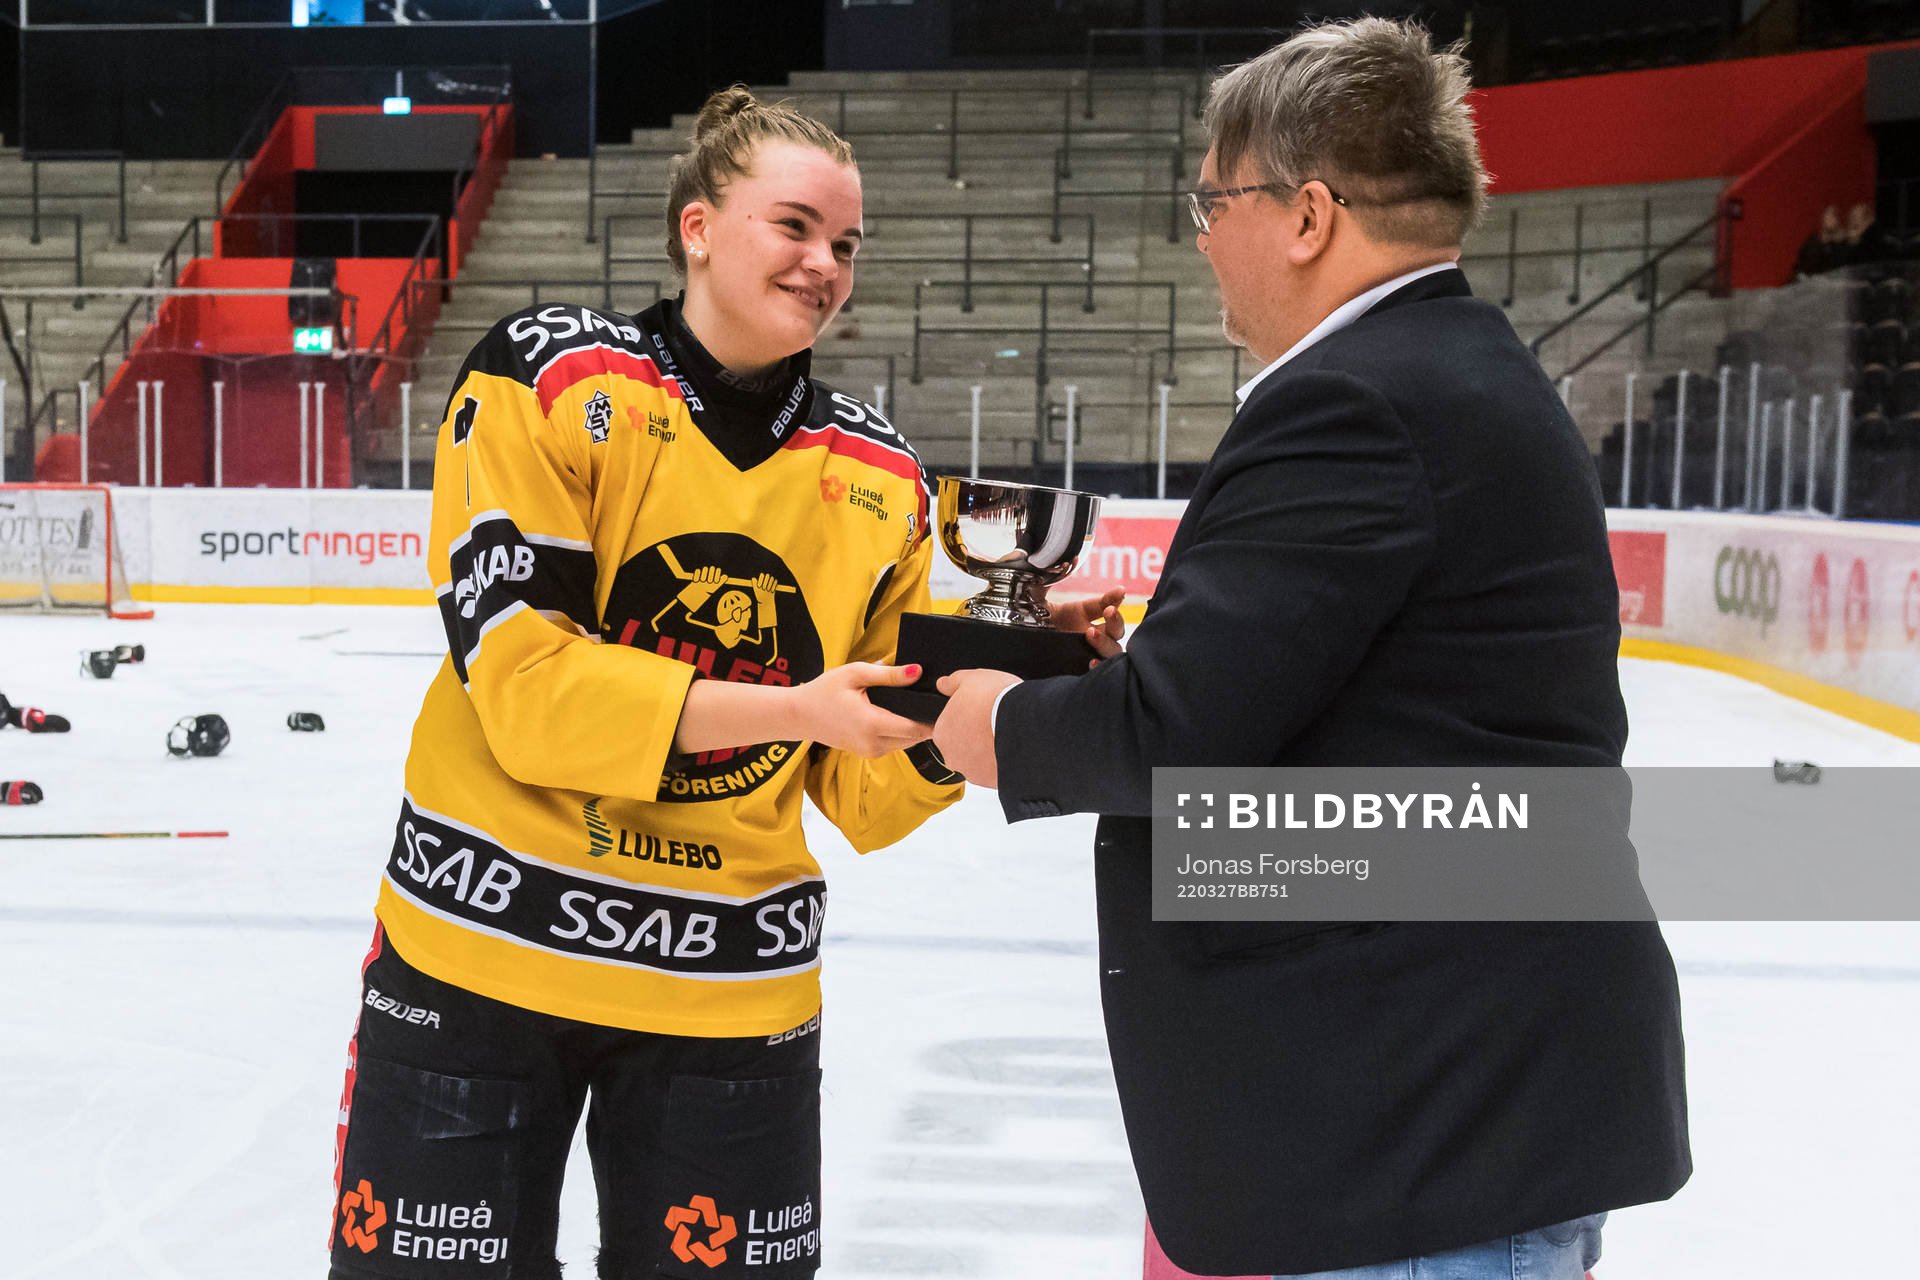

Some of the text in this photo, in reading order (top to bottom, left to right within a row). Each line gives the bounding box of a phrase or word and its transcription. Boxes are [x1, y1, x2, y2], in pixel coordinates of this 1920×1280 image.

[849, 495, 889, 522] Energi
[200, 527, 421, 565] sportringen
[473, 545, 535, 605] KAB
[659, 743, 788, 795] FÖRENING
[397, 820, 521, 914] SSAB
[617, 828, 723, 871] LULEBO
[550, 889, 718, 959] SSAB
[396, 1198, 492, 1229] Luleå
[748, 1193, 812, 1234] Luleå
[392, 1229, 508, 1264] Energi
[745, 1227, 819, 1266] Energi
